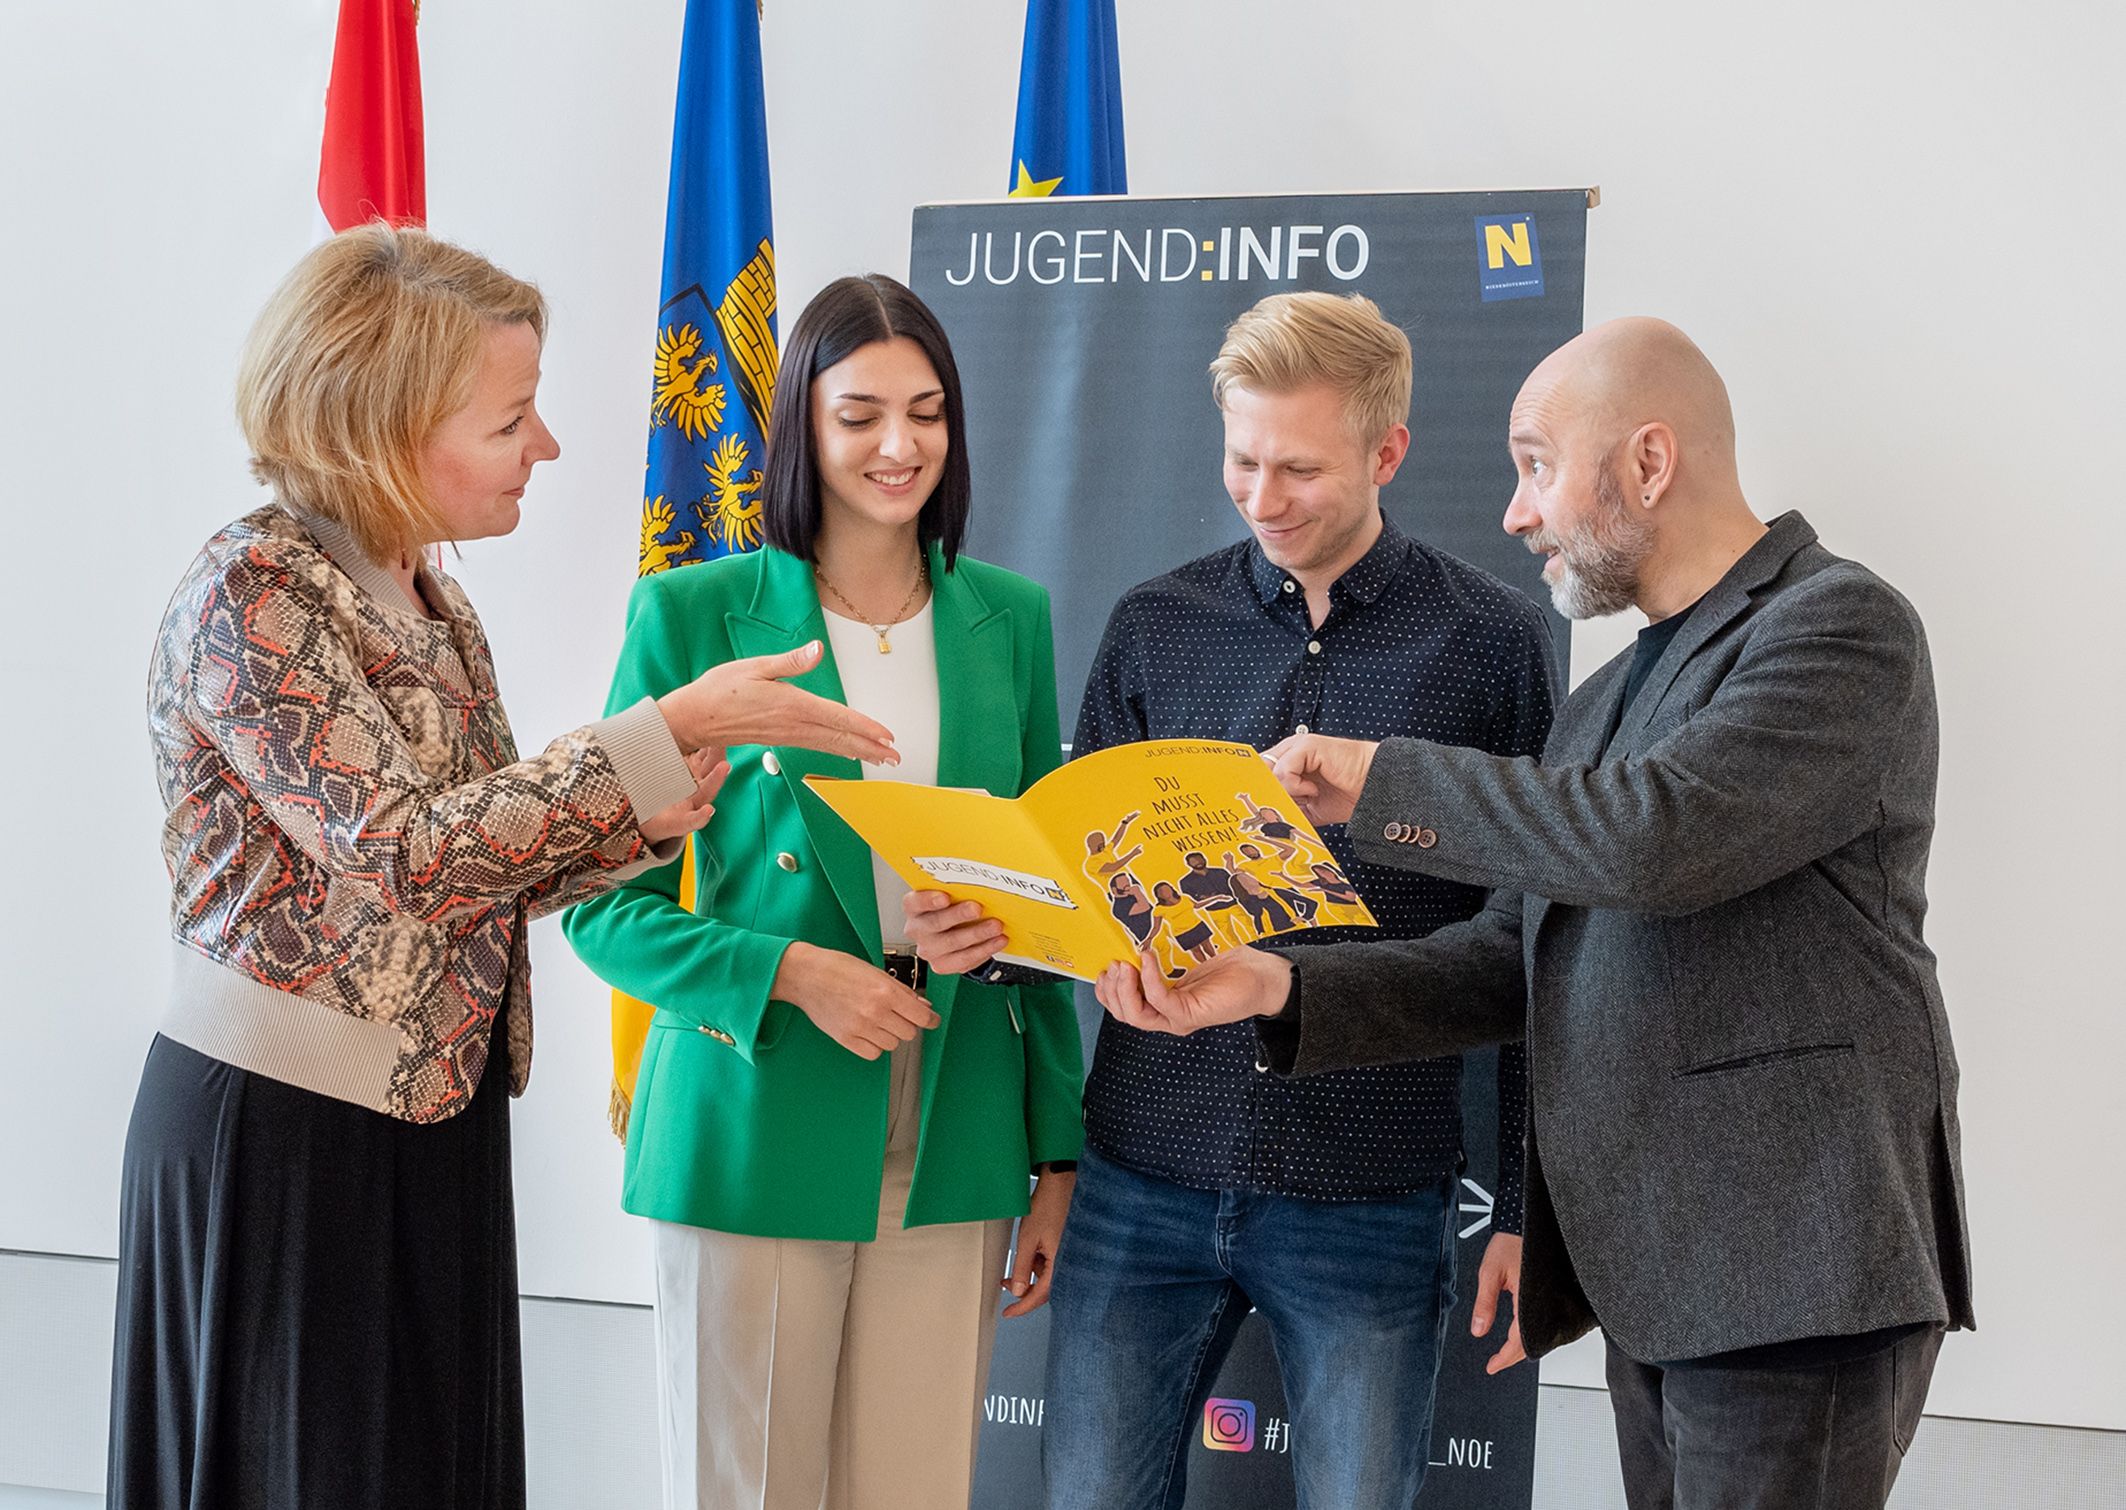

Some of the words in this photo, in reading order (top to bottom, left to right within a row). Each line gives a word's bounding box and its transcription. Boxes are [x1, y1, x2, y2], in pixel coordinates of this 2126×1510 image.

[945, 224, 1370, 286] JUGEND:INFO
[1485, 222, 1532, 269] N
[1154, 776, 1180, 792] DU
[1152, 793, 1205, 815] MUSST
[1143, 815, 1192, 840] NICHT
[1196, 809, 1239, 826] ALLES
[1172, 826, 1239, 853] WISSEN!
